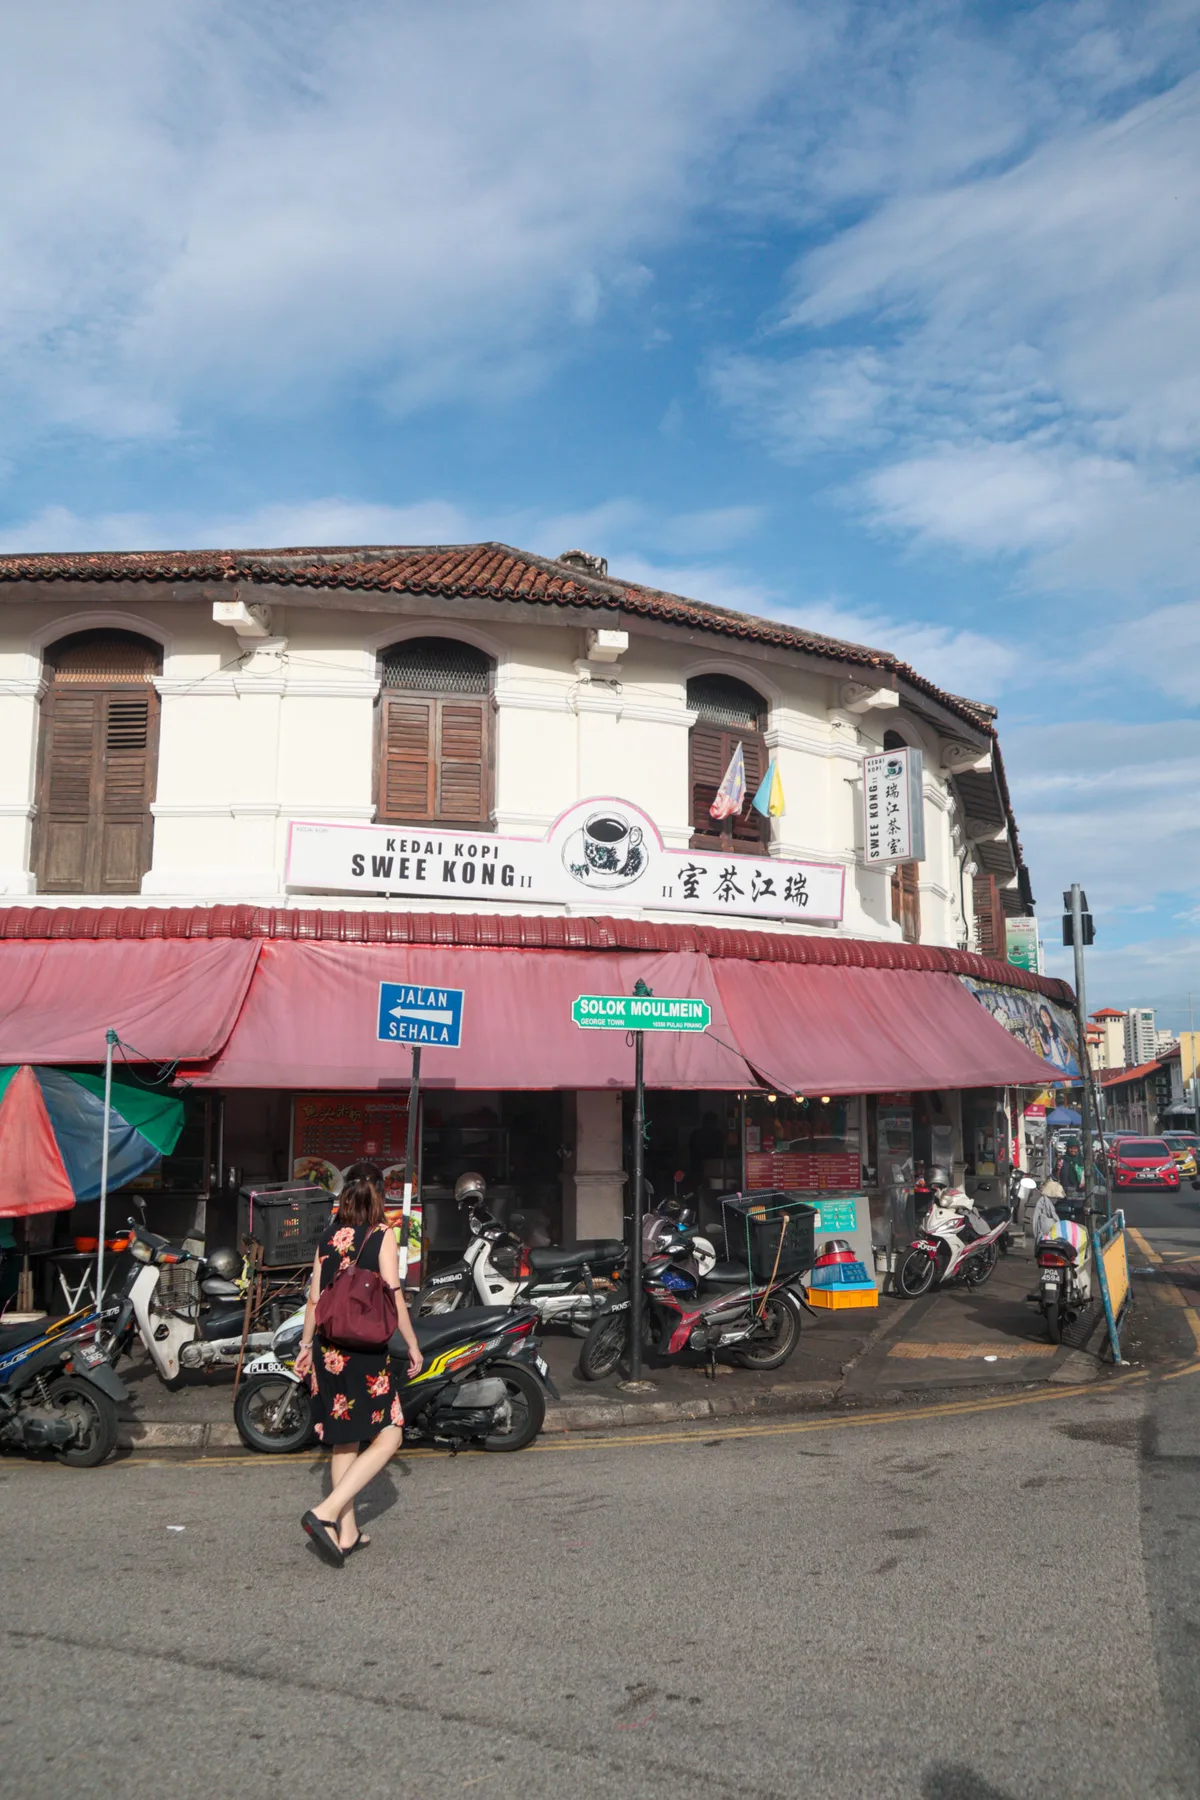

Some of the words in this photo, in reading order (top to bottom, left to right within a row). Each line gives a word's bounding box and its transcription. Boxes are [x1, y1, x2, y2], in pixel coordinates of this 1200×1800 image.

[868, 758, 885, 766] KEDAI
[869, 785, 878, 818] KONG
[886, 783, 901, 855] 瑞江茶室
[386, 838, 442, 856] KEDAI
[454, 843, 498, 859] KOPI
[870, 824, 880, 857] SWEE
[351, 854, 426, 881] SWEE
[442, 860, 515, 887] KONG
[396, 988, 447, 1007] JALAN
[580, 999, 626, 1016] SOLOK
[631, 1001, 703, 1017] MOULMEIN
[389, 1021, 449, 1042] SEHALA
[580, 1018, 606, 1026] GEORGE
[1041, 1274, 1060, 1282] 4594
[1044, 1268, 1059, 1276] PGA
[251, 1362, 267, 1372] PLL
